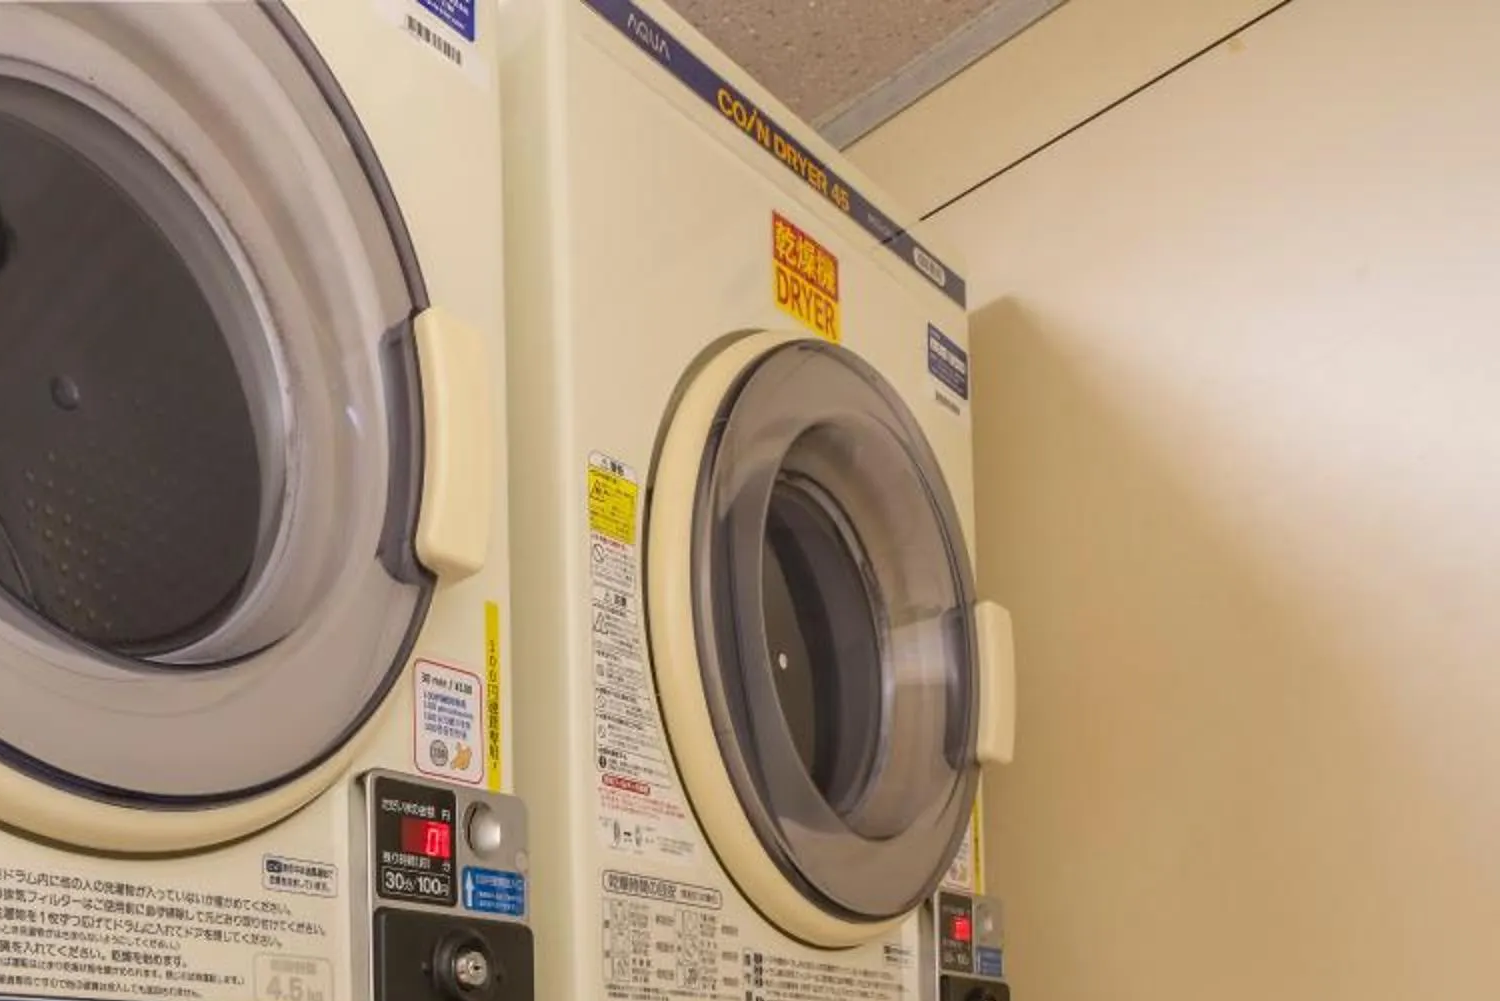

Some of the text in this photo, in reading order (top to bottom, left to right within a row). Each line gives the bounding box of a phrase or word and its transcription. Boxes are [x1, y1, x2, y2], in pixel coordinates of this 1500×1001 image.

[627, 13, 671, 62] AQUA
[774, 134, 827, 195] DRYER
[775, 220, 836, 298] 乾燥機
[777, 266, 837, 340] DRYER
